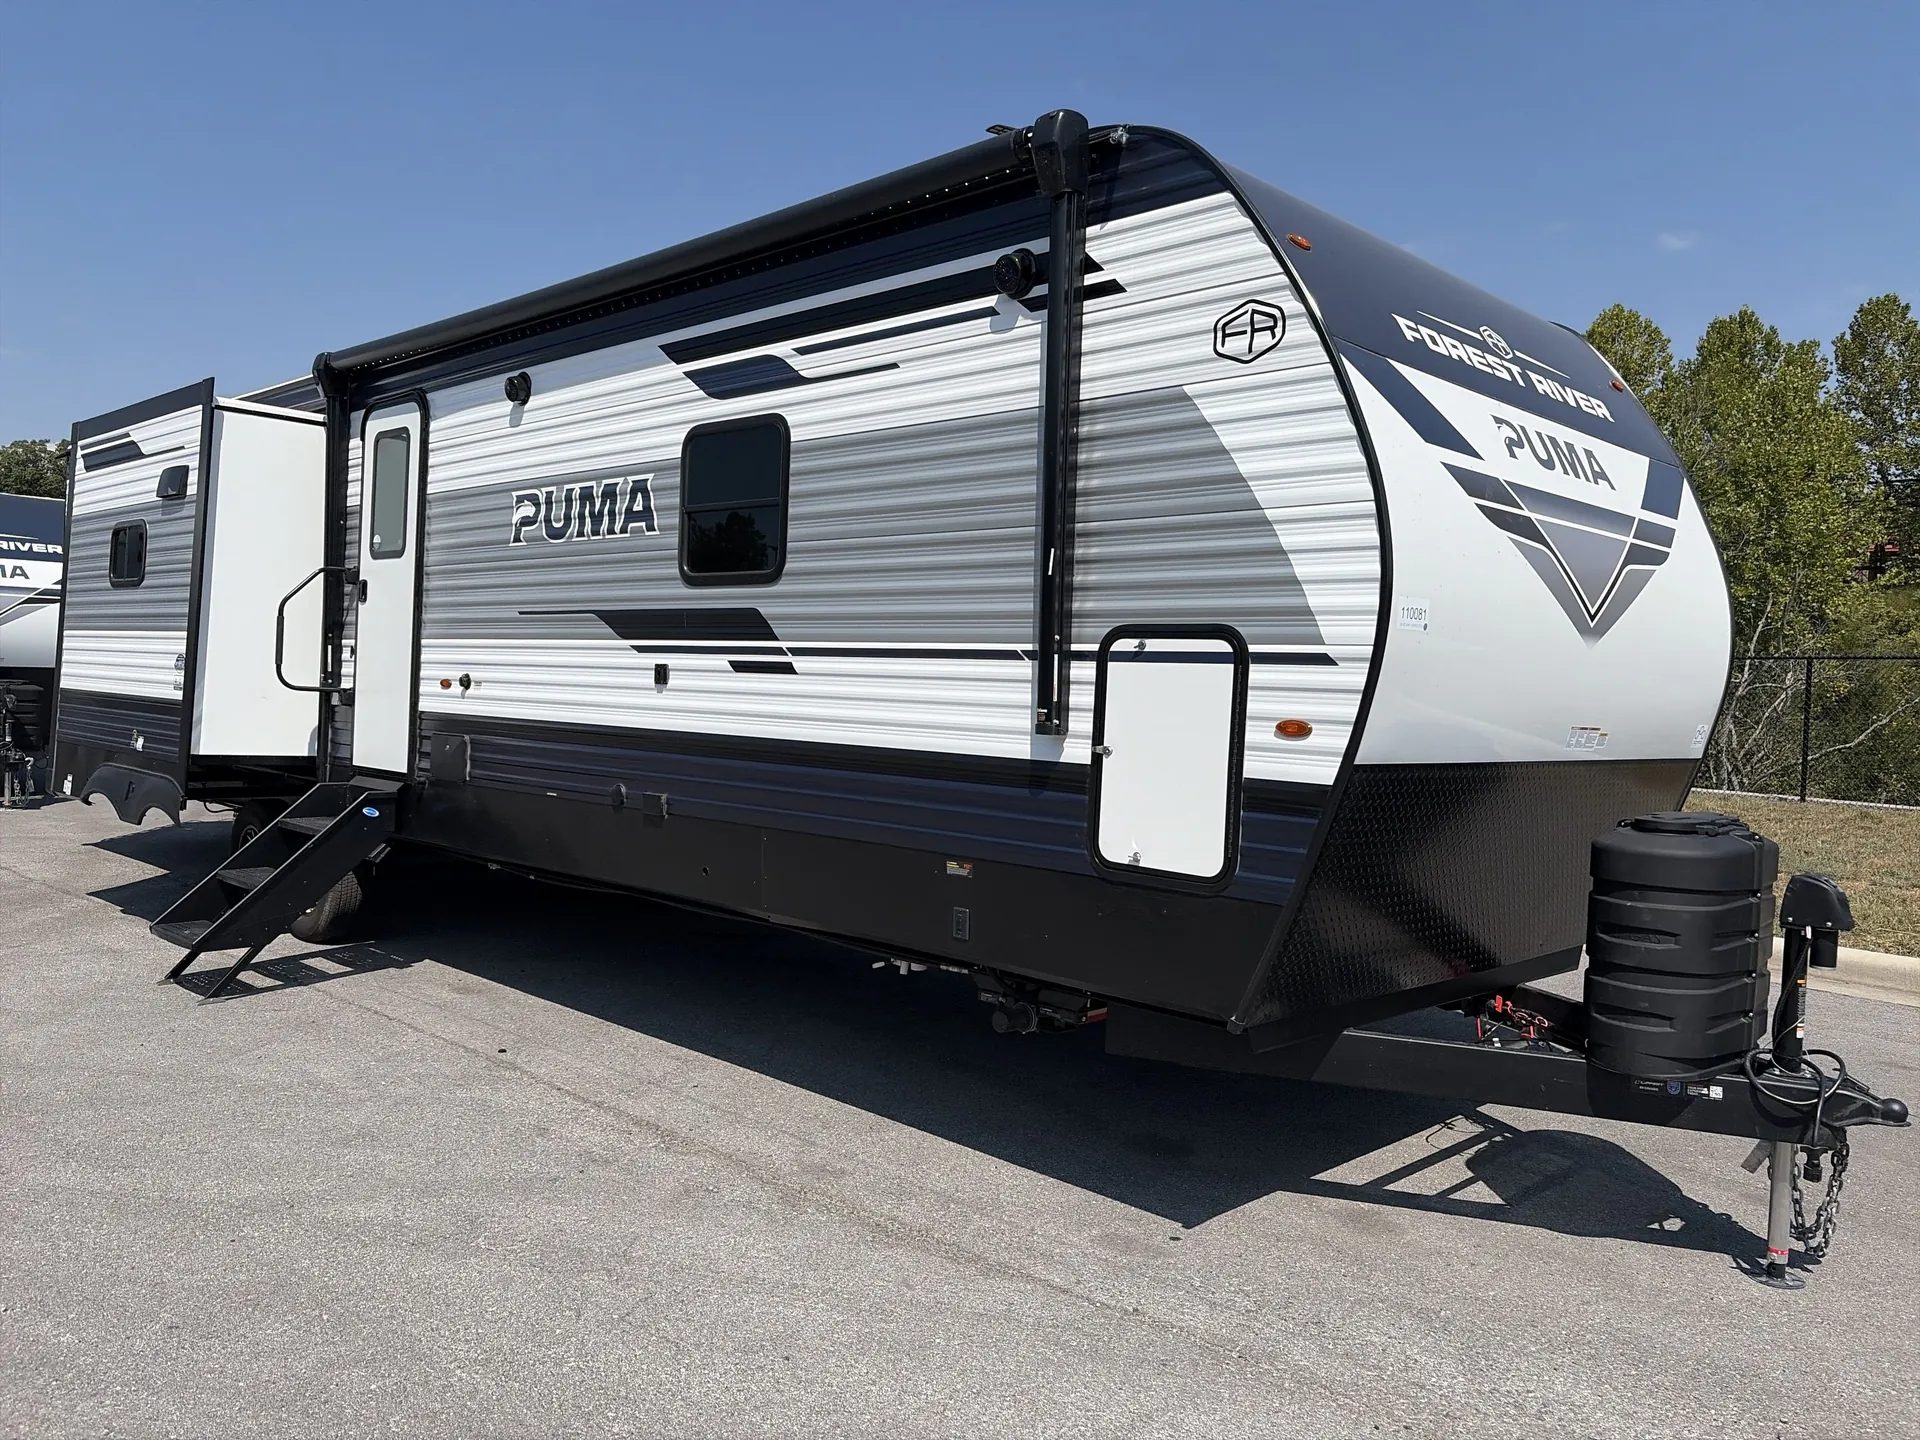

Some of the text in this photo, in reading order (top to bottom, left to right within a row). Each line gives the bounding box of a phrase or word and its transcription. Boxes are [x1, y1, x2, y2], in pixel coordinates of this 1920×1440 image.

[1220, 307, 1279, 355] FR
[1391, 312, 1615, 423] FOREST RIVER
[1490, 413, 1617, 491] PUMA
[508, 473, 660, 546] PUMA
[1401, 606, 1427, 621] 110081
